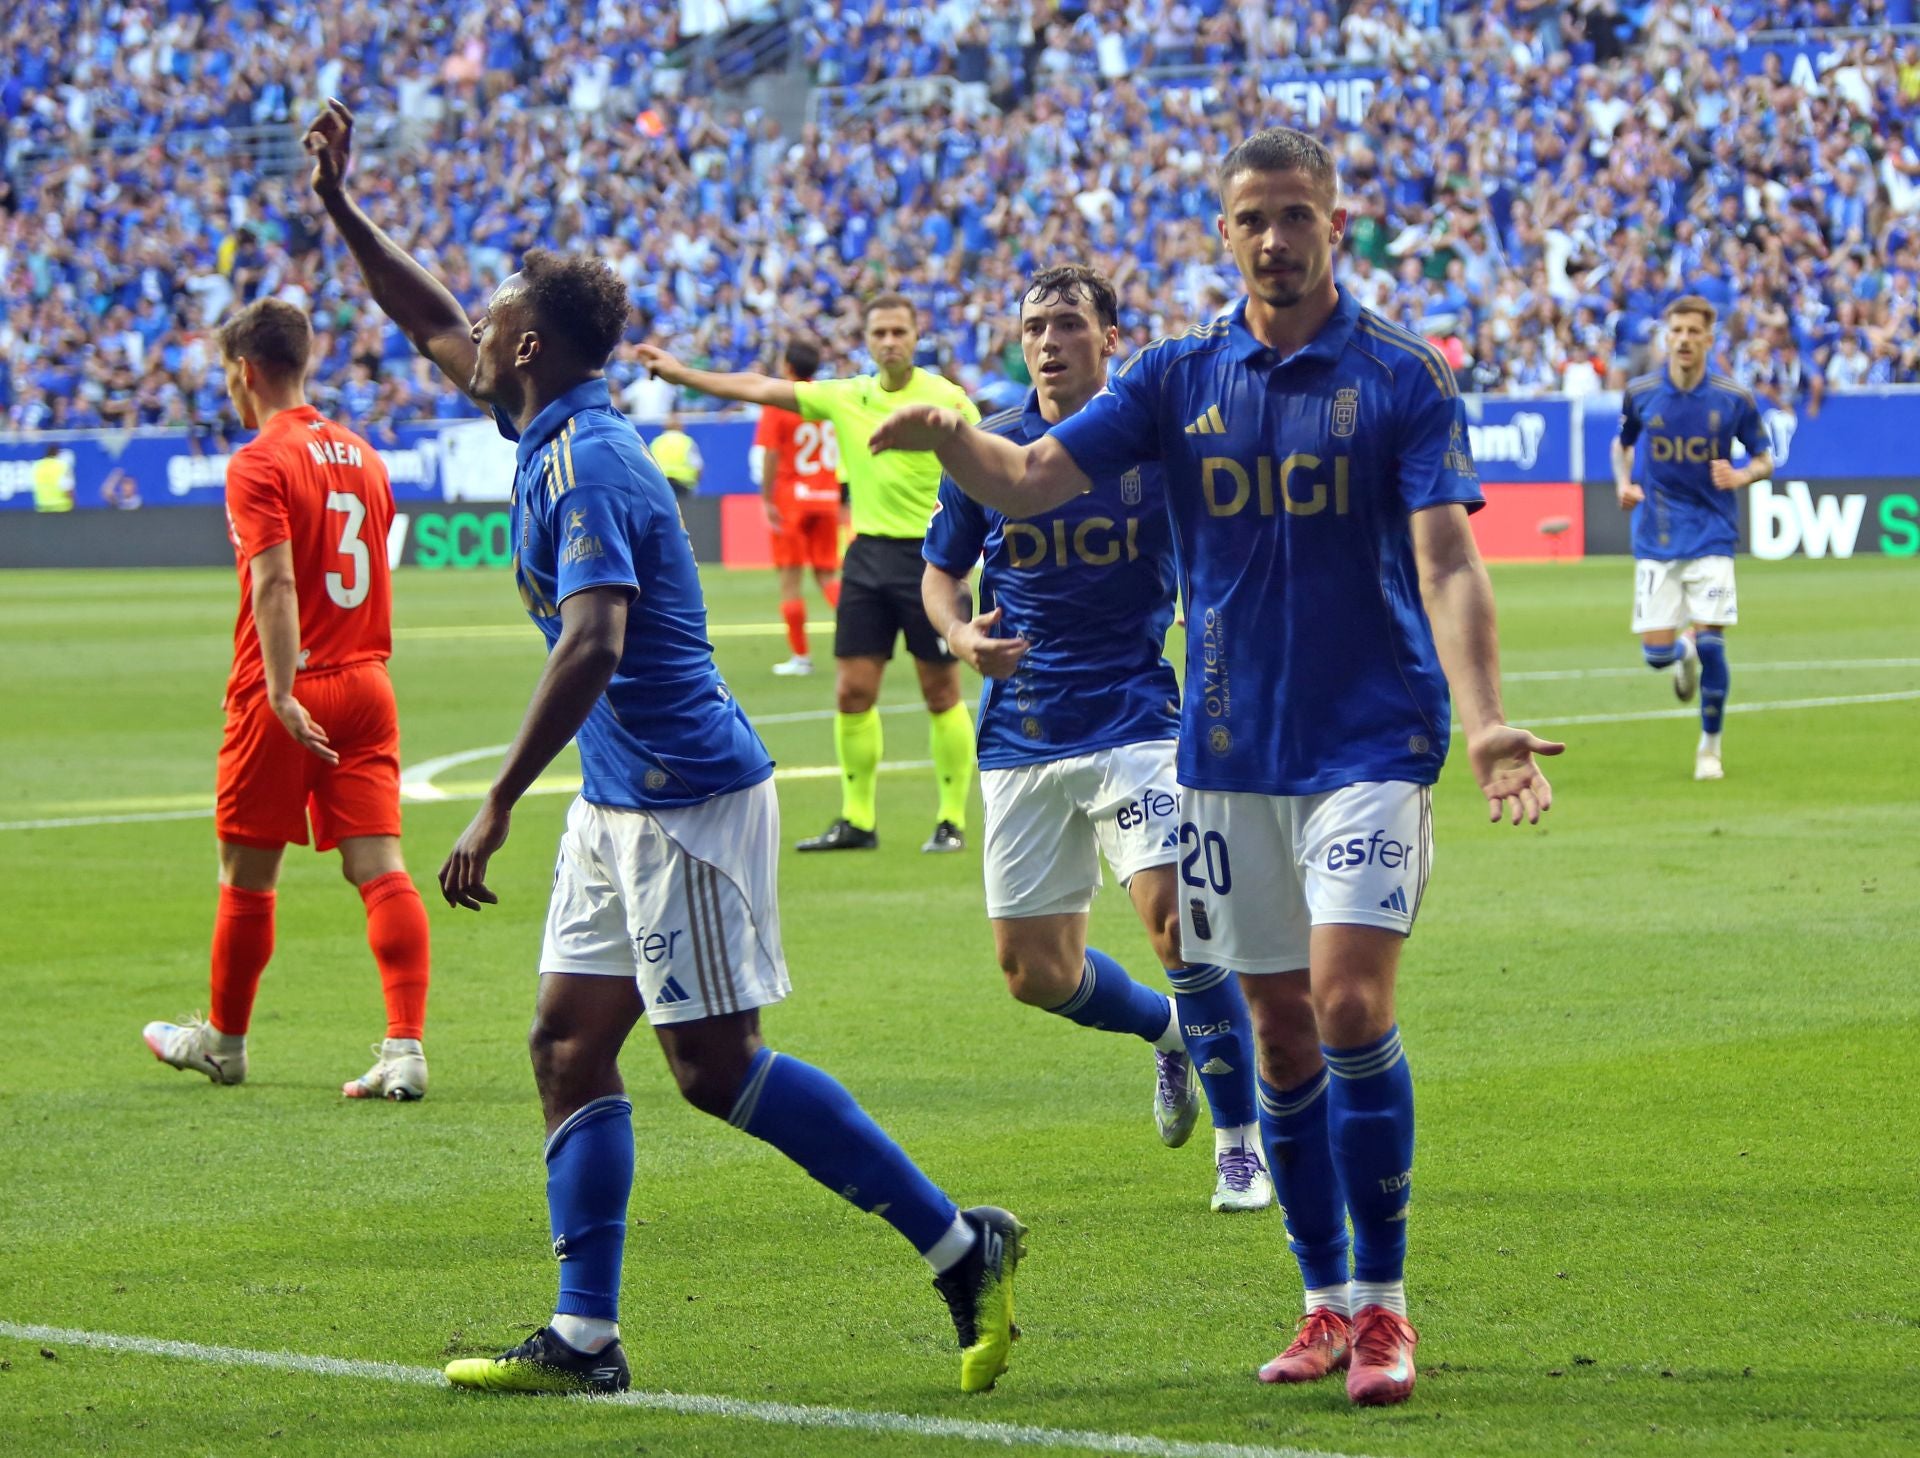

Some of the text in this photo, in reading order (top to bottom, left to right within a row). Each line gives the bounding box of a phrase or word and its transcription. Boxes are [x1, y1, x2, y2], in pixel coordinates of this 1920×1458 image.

[794, 419, 841, 477] 28
[1652, 436, 1719, 464] DIGI
[1202, 453, 1350, 517] DIGI
[325, 491, 370, 609] 3
[1003, 516, 1140, 568] DIGI
[1204, 607, 1221, 718] OVIEDO
[1179, 822, 1232, 895] 20
[1327, 829, 1413, 871] esfer
[635, 926, 682, 965] fer
